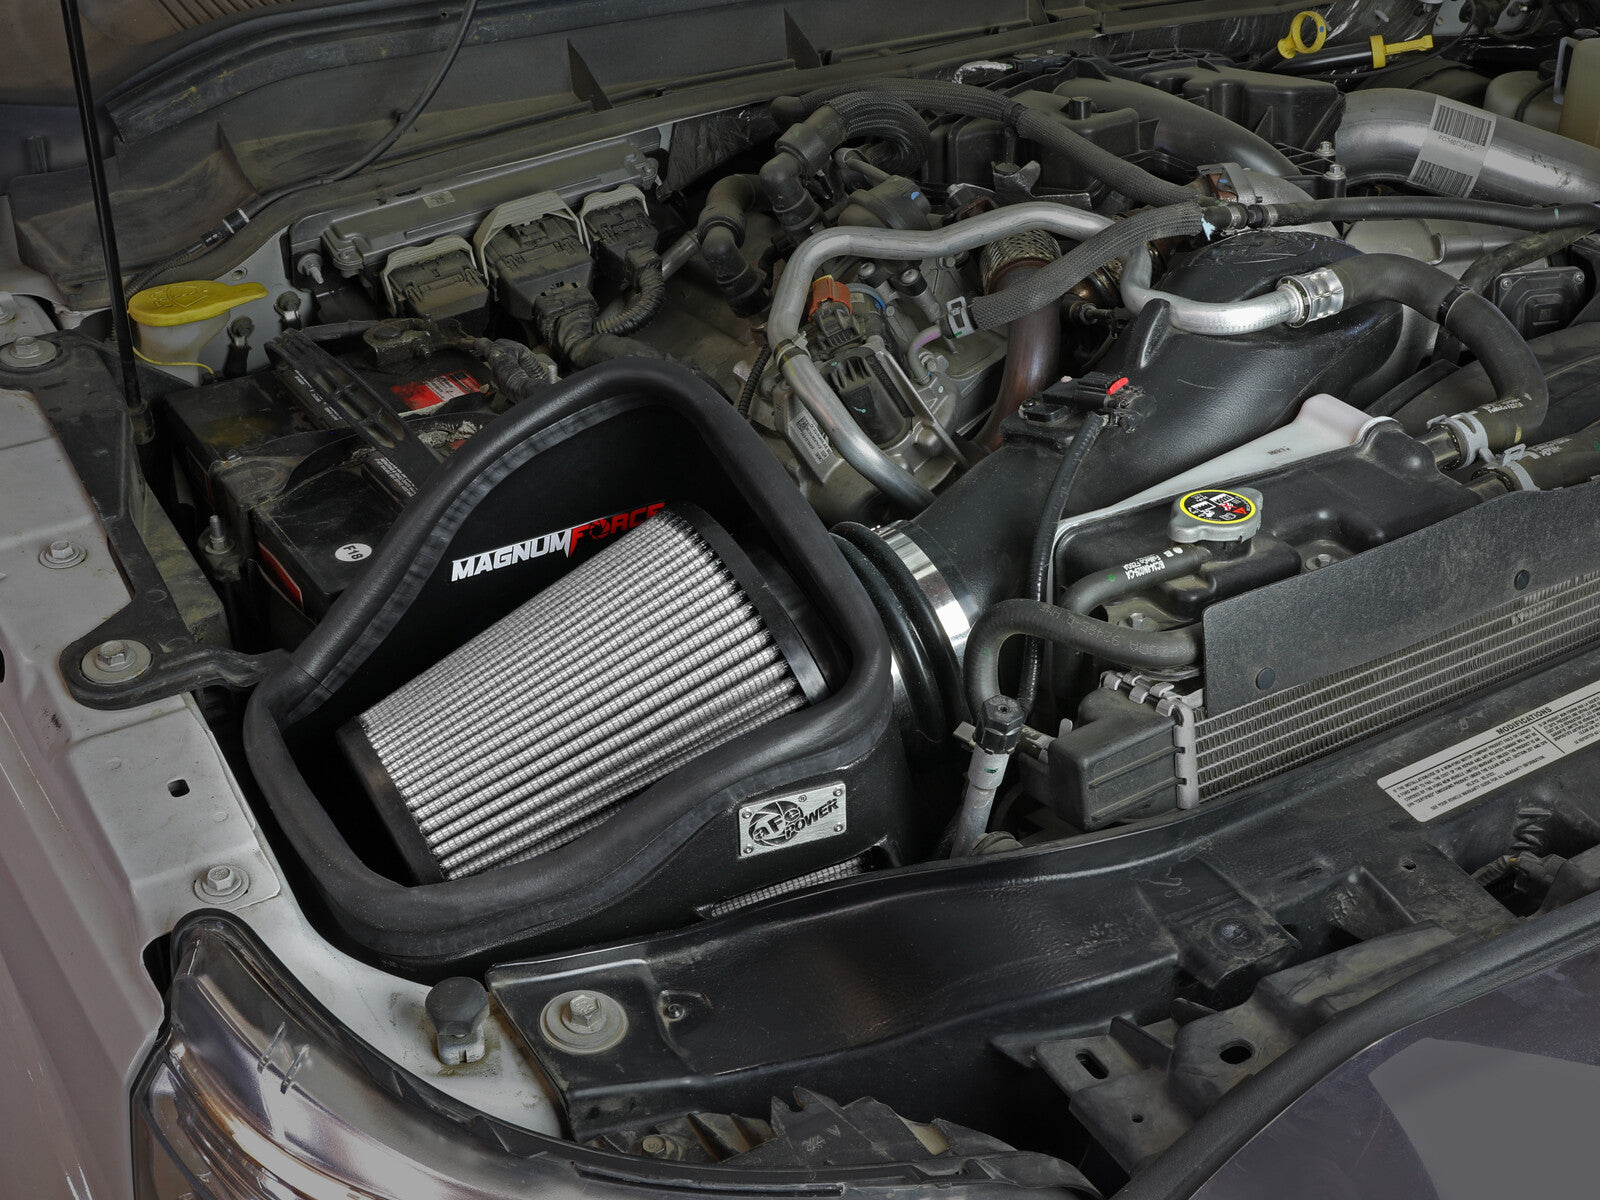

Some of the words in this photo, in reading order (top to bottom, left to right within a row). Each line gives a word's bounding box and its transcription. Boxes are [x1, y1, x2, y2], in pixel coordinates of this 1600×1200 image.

[343, 545, 363, 560] F18
[1495, 706, 1553, 735] MODIFICATIONS
[785, 799, 839, 840] POWER
